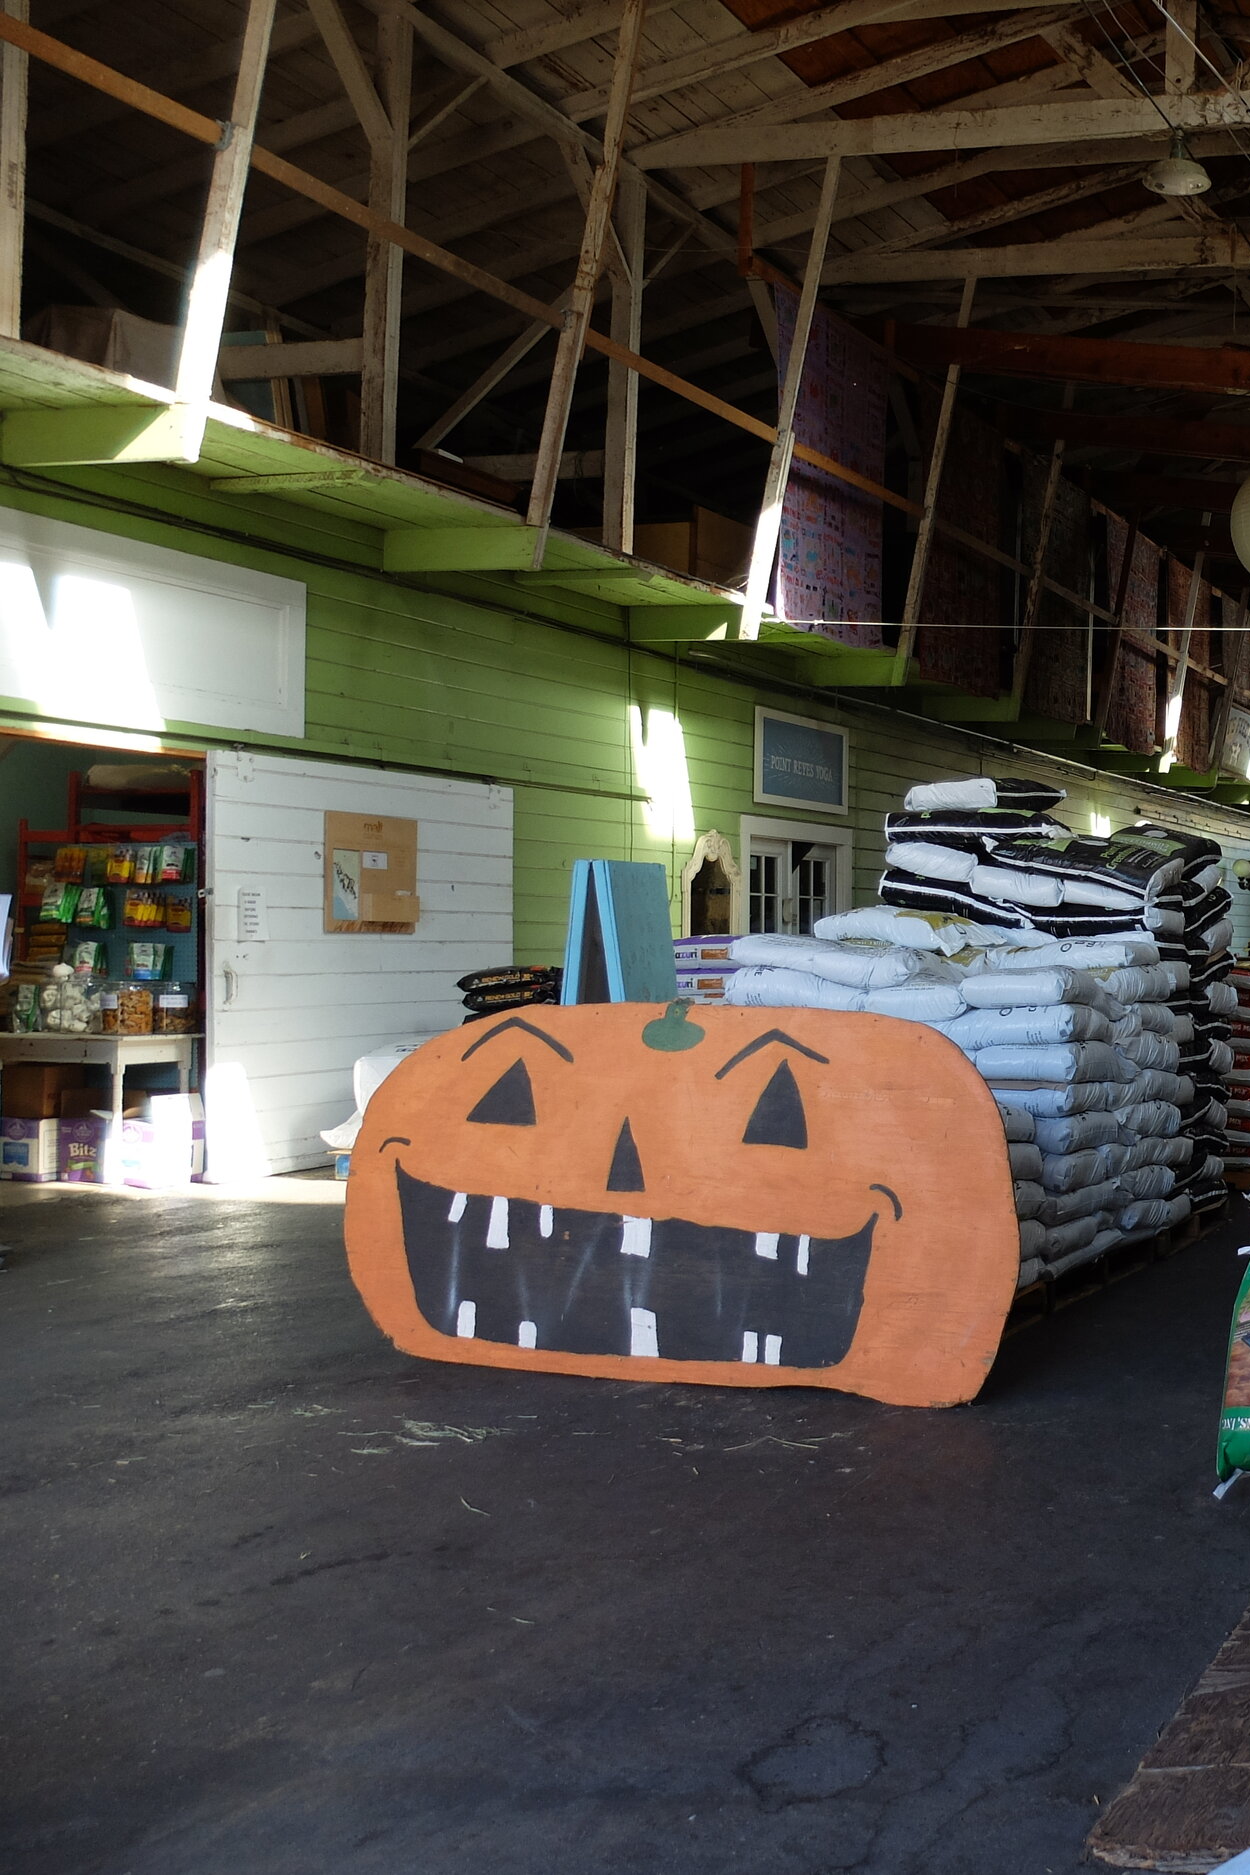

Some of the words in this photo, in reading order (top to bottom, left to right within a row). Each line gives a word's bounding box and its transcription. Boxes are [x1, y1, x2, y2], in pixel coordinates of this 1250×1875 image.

[771, 755, 791, 772] POINT
[793, 760, 814, 777] REYES
[815, 765, 833, 782] YOGA
[675, 948, 698, 959] azuri
[68, 1142, 97, 1157] Bitz
